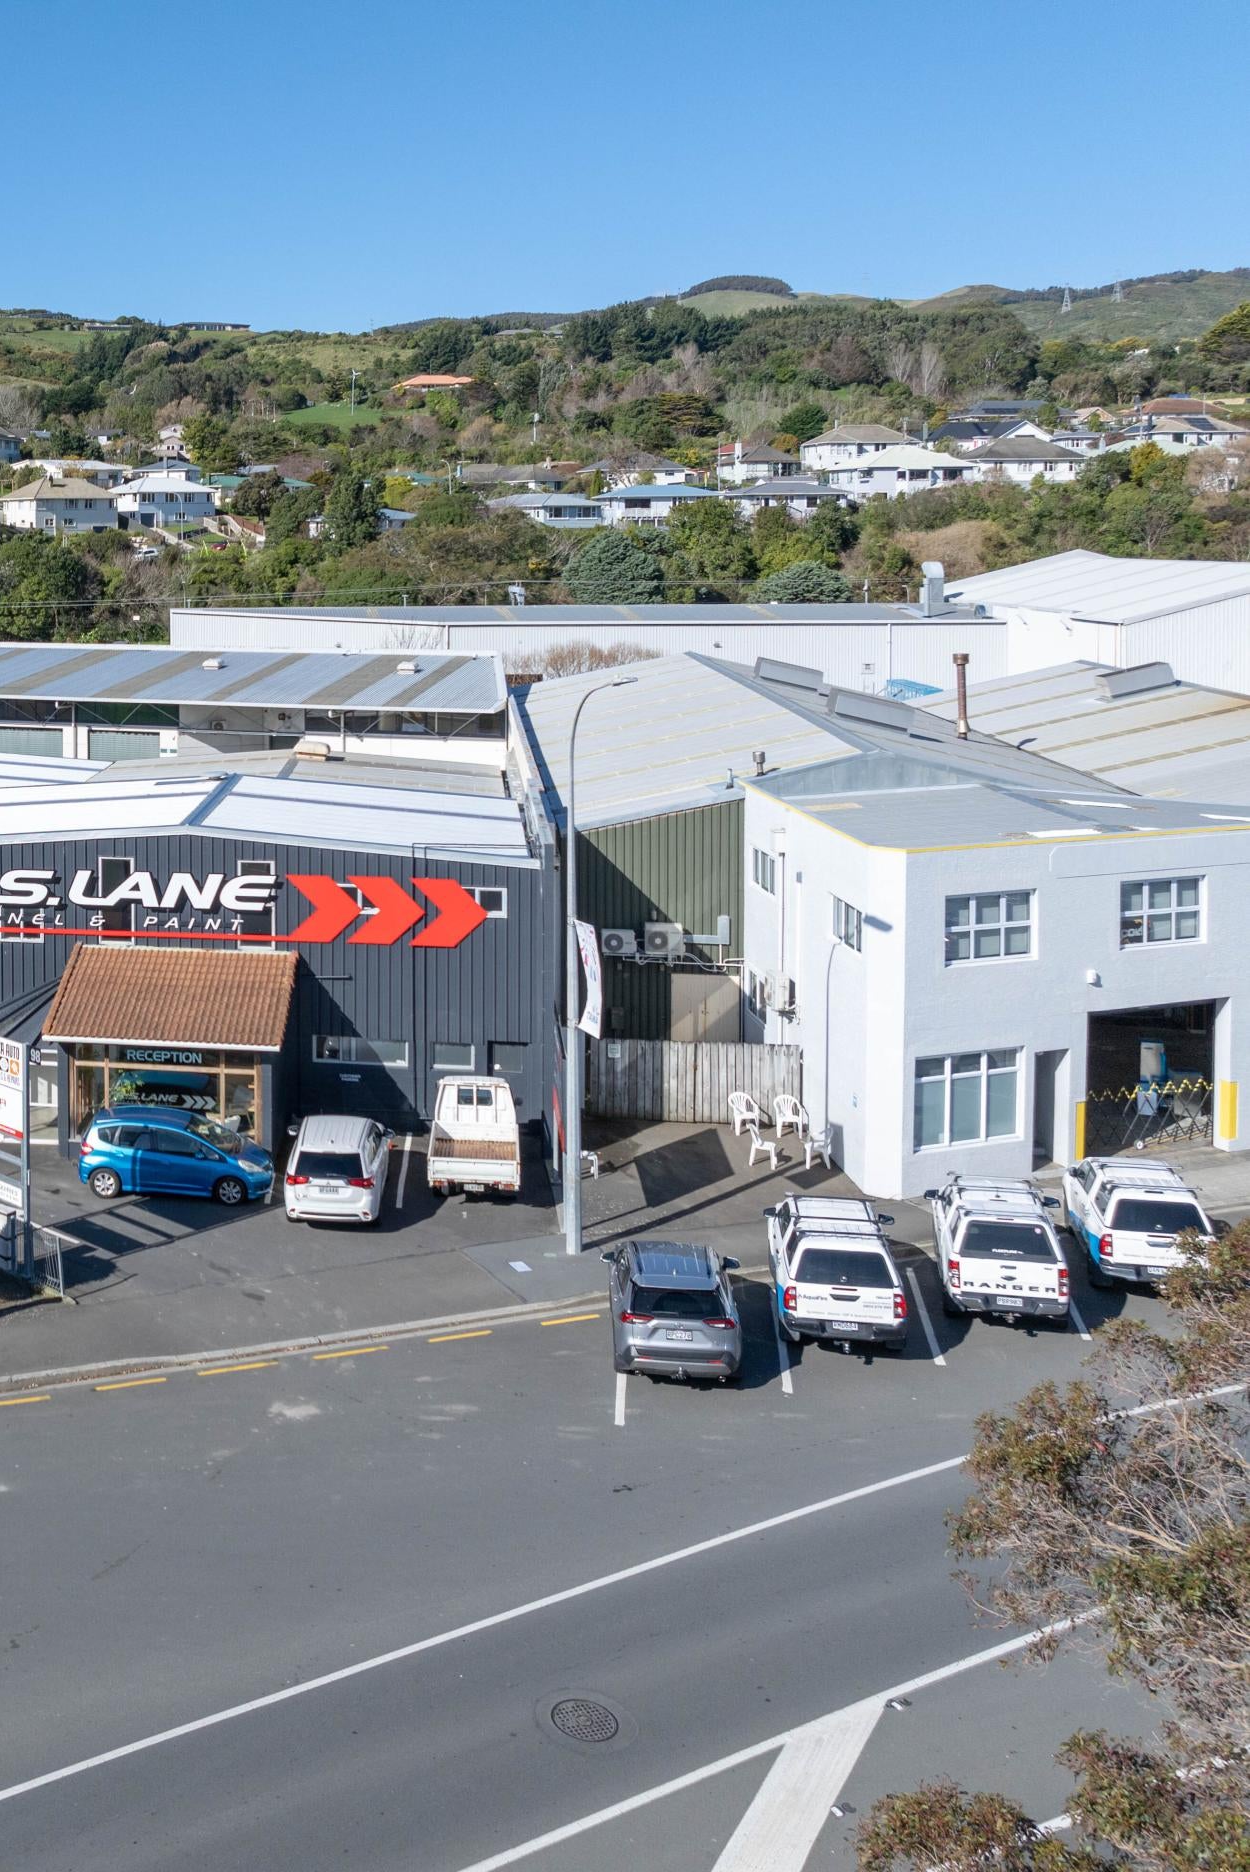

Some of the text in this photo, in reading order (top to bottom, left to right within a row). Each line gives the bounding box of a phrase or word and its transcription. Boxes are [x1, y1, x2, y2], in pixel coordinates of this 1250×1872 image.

[89, 916, 106, 927] &
[143, 917, 244, 932] PAINT
[6, 1044, 20, 1060] AUTO
[30, 1048, 41, 1062] 98
[126, 1049, 202, 1064] RECEPTION
[963, 1281, 1056, 1293] RANGER
